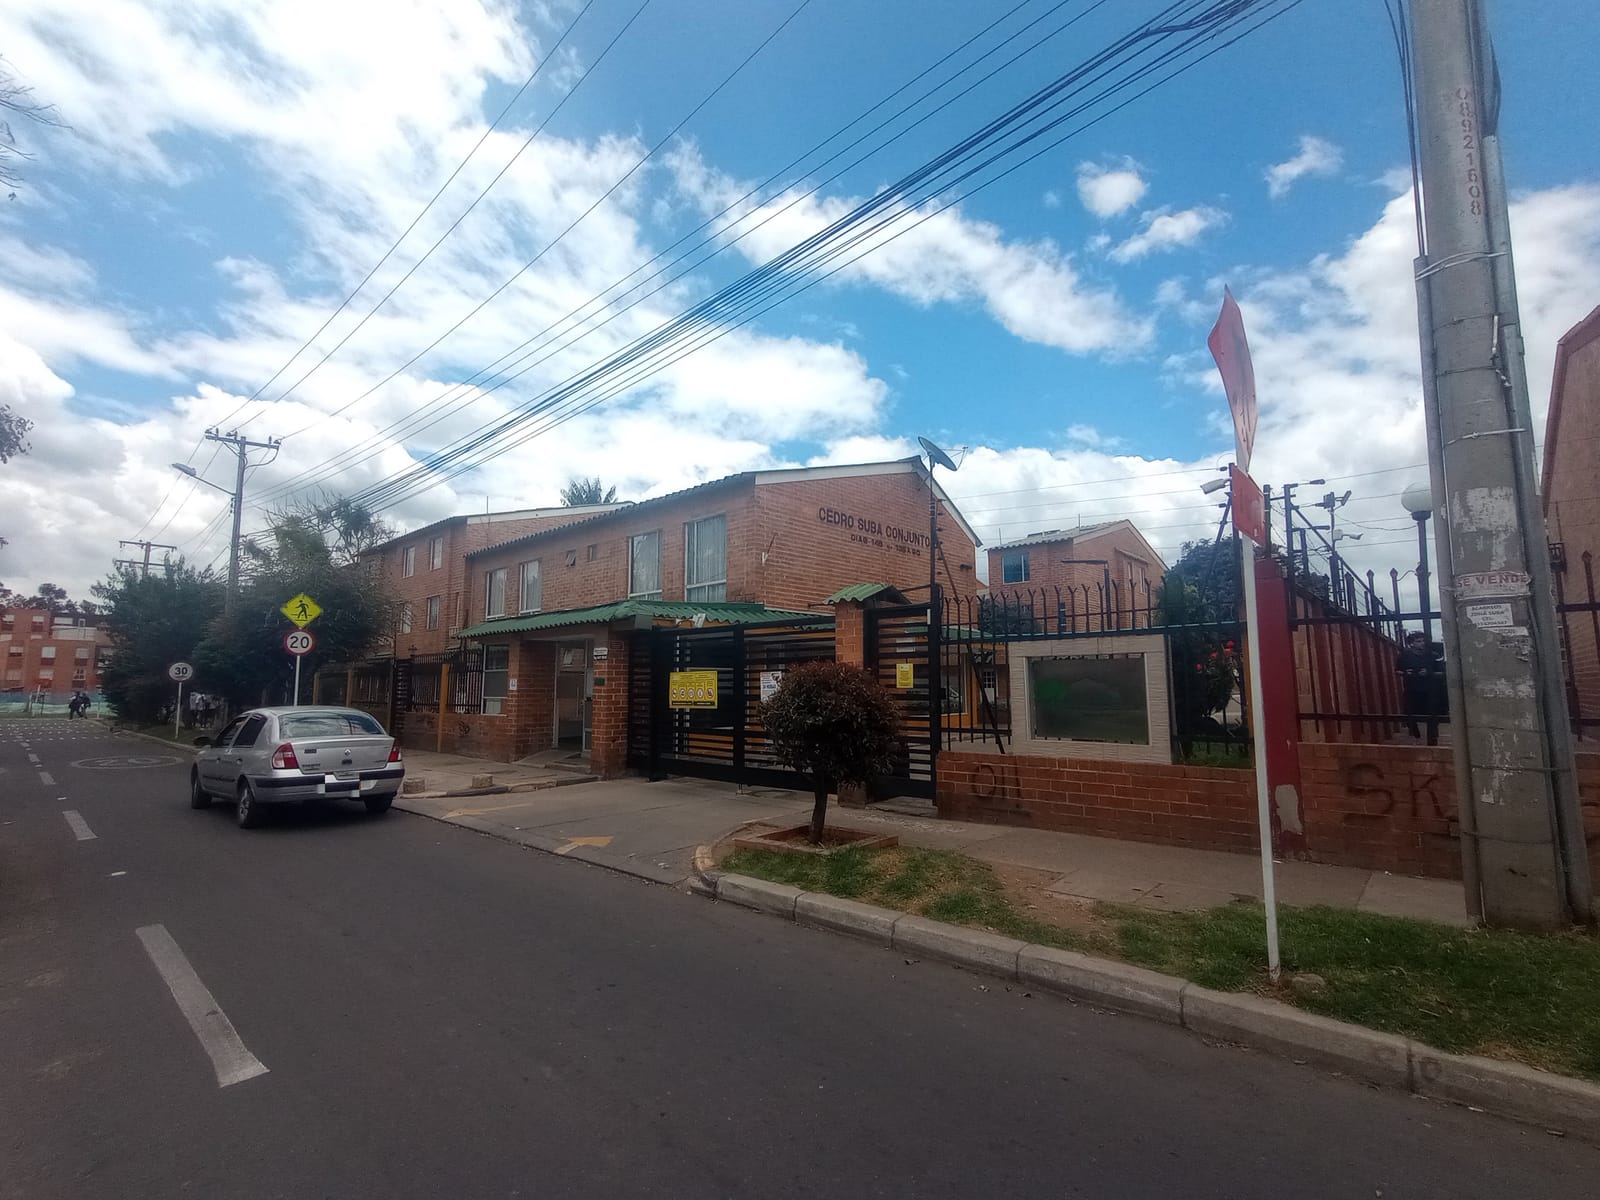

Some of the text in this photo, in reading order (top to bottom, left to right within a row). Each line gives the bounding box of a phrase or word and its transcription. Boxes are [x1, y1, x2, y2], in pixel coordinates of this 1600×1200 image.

[819, 508, 930, 548] CEDRO SUBA CONJUNTO
[1476, 574, 1527, 584] VENDE
[289, 635, 310, 649] 20
[174, 666, 188, 676] 30
